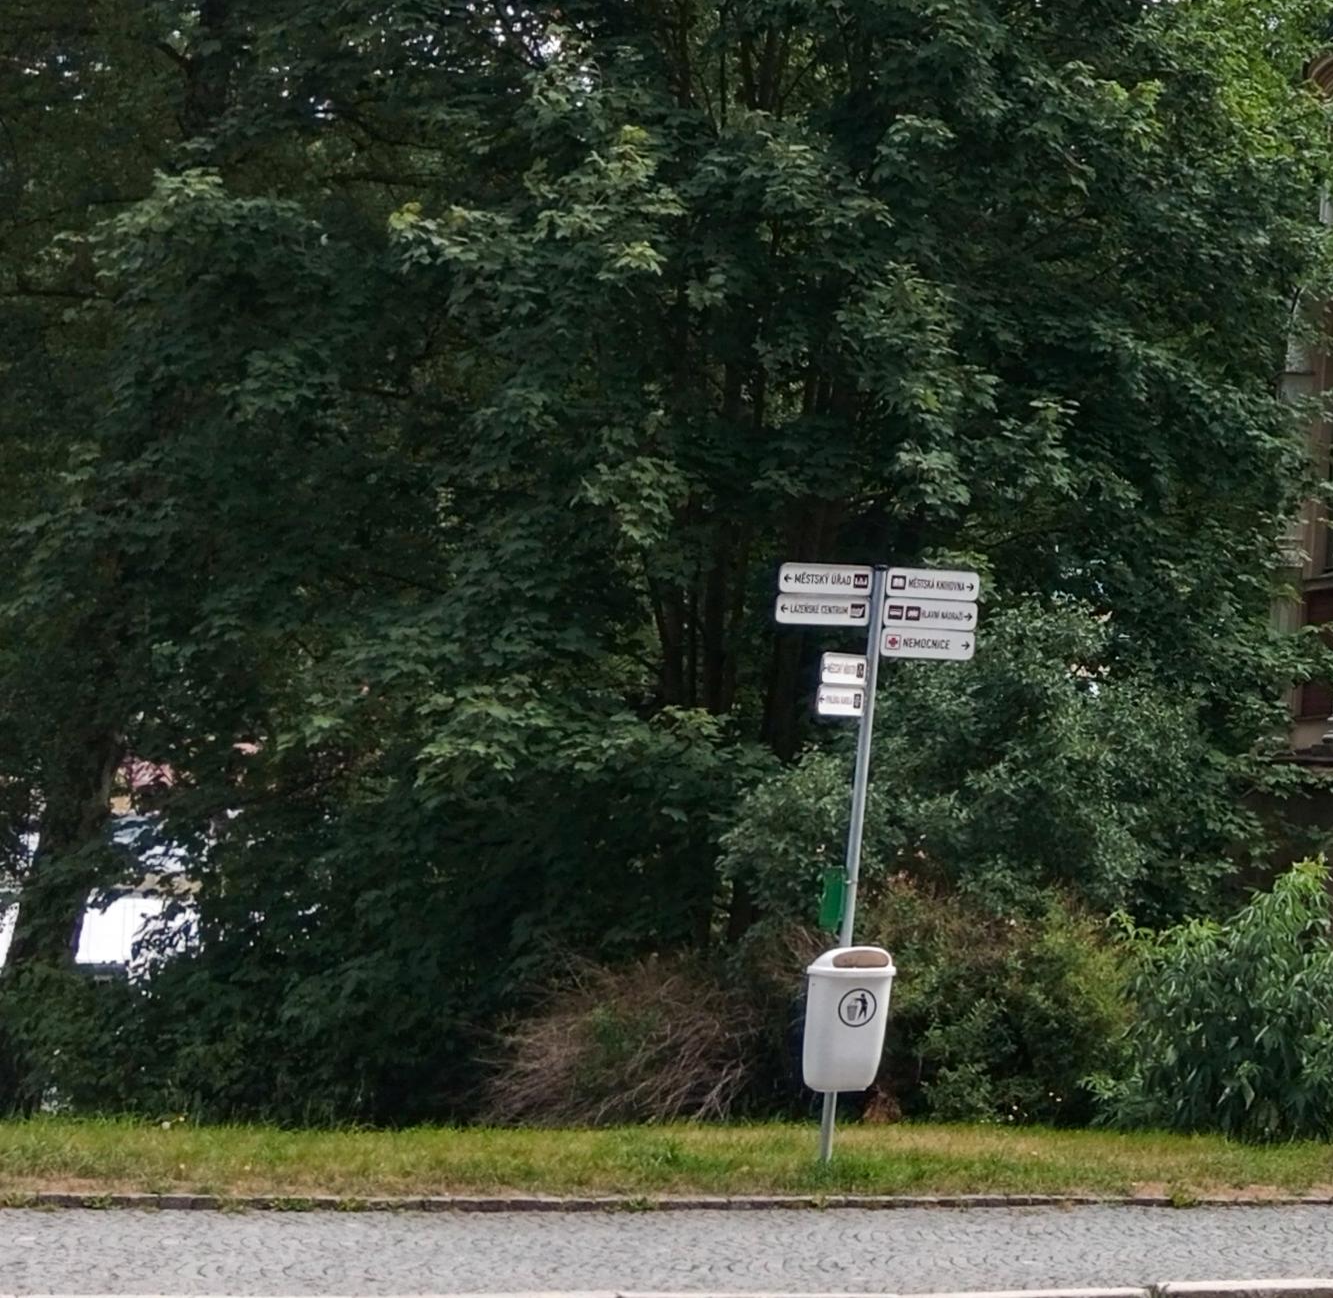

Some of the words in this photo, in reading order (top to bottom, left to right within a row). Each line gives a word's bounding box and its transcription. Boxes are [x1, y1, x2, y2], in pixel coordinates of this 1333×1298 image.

[795, 571, 829, 584] MĚSTSKÝ
[831, 573, 852, 585] ÚŘAD
[903, 638, 950, 649] NEMOCNICE
